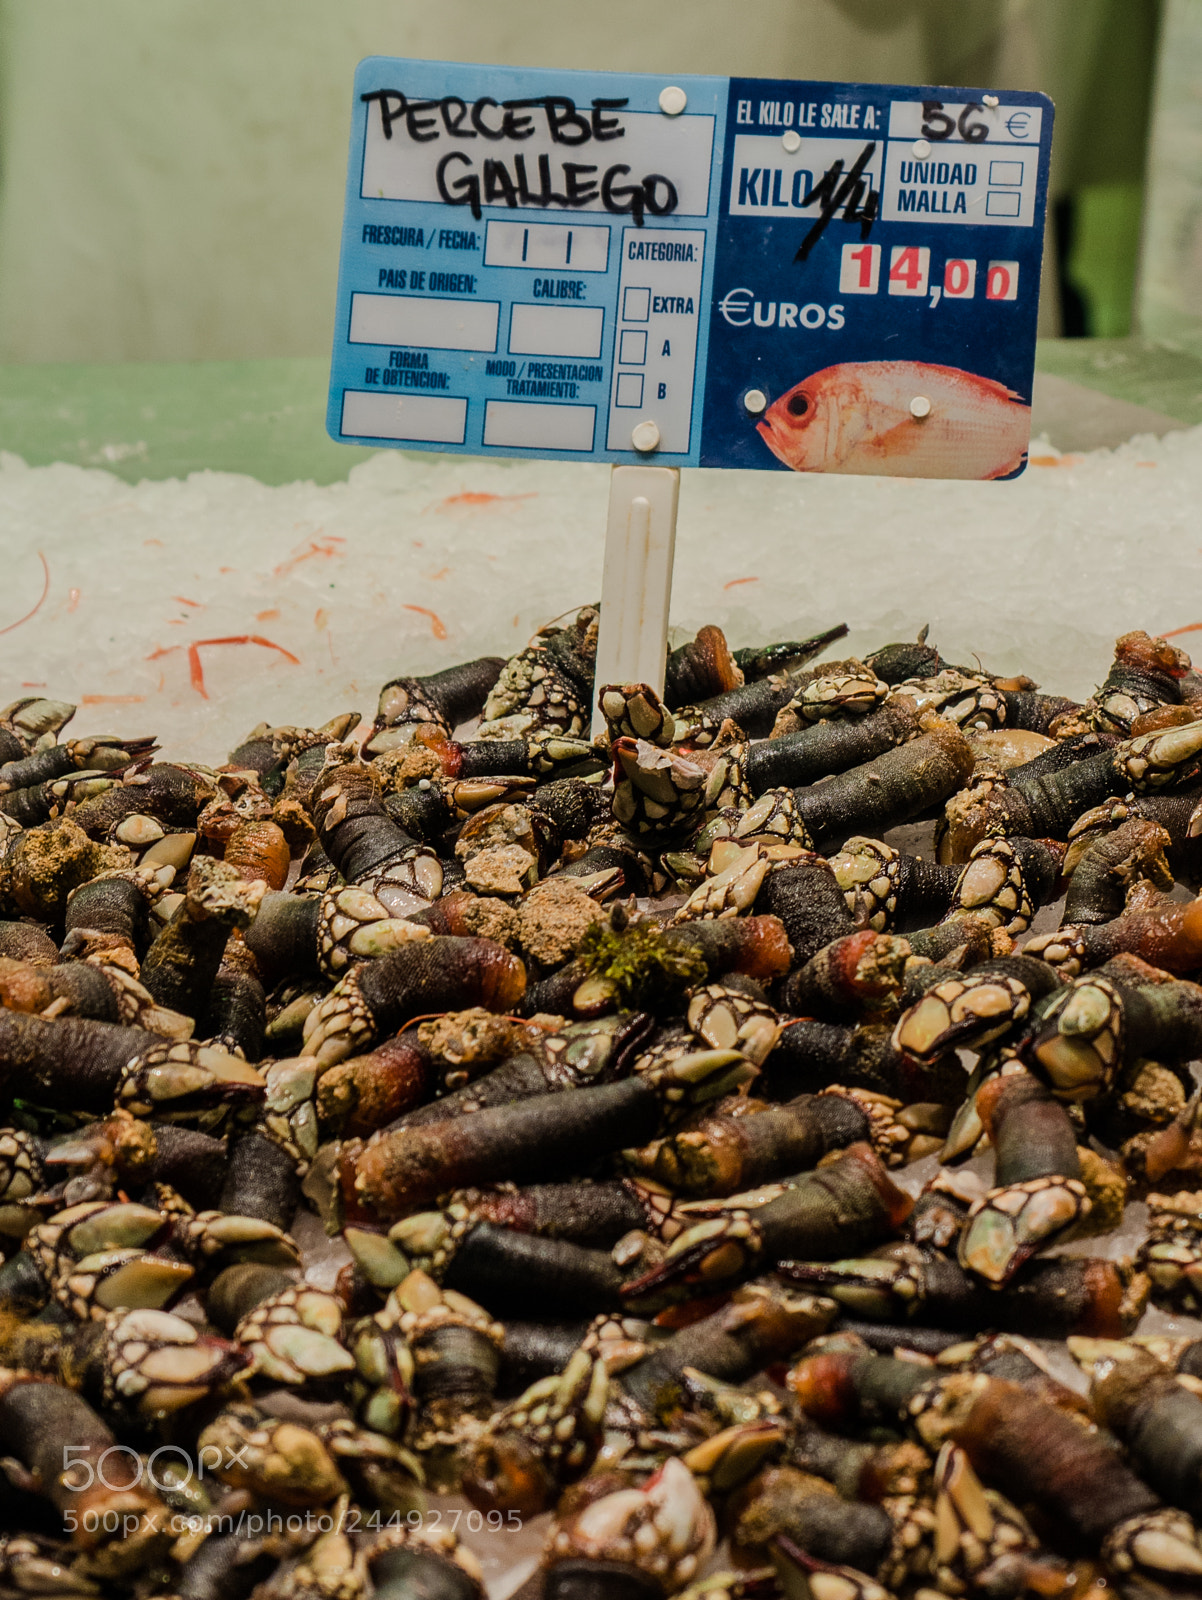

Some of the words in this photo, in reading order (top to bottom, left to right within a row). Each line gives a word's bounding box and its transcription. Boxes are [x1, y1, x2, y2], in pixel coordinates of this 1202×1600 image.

[361, 89, 630, 145] PERCEBE
[737, 100, 754, 125] EL
[758, 101, 795, 127] KILO
[799, 103, 817, 127] LE
[820, 104, 860, 129] SALE
[863, 106, 881, 130] A:
[921, 100, 990, 143] 56
[1005, 112, 1032, 139] €
[900, 161, 977, 186] UNIDAD
[436, 151, 678, 227] GALLEGO
[738, 168, 813, 208] KILO
[897, 190, 967, 214] MALLA
[362, 225, 424, 247] FRESCURA
[438, 230, 481, 250] FECHA:
[628, 241, 698, 262] CATEGORIA:
[378, 268, 406, 289] PAIS
[409, 271, 426, 291] DE
[429, 272, 477, 294] ORIGEN:
[533, 278, 587, 300] CALIBRE:
[652, 296, 695, 314] EXTRA
[388, 351, 429, 369] FORMA
[661, 340, 671, 357] A
[365, 367, 380, 384] DE
[382, 369, 450, 390] OBTENCION:
[485, 359, 516, 378] MODO
[527, 362, 604, 383] PRESENTACION
[506, 378, 580, 400] TRATAMIENTO:
[657, 383, 668, 400] B
